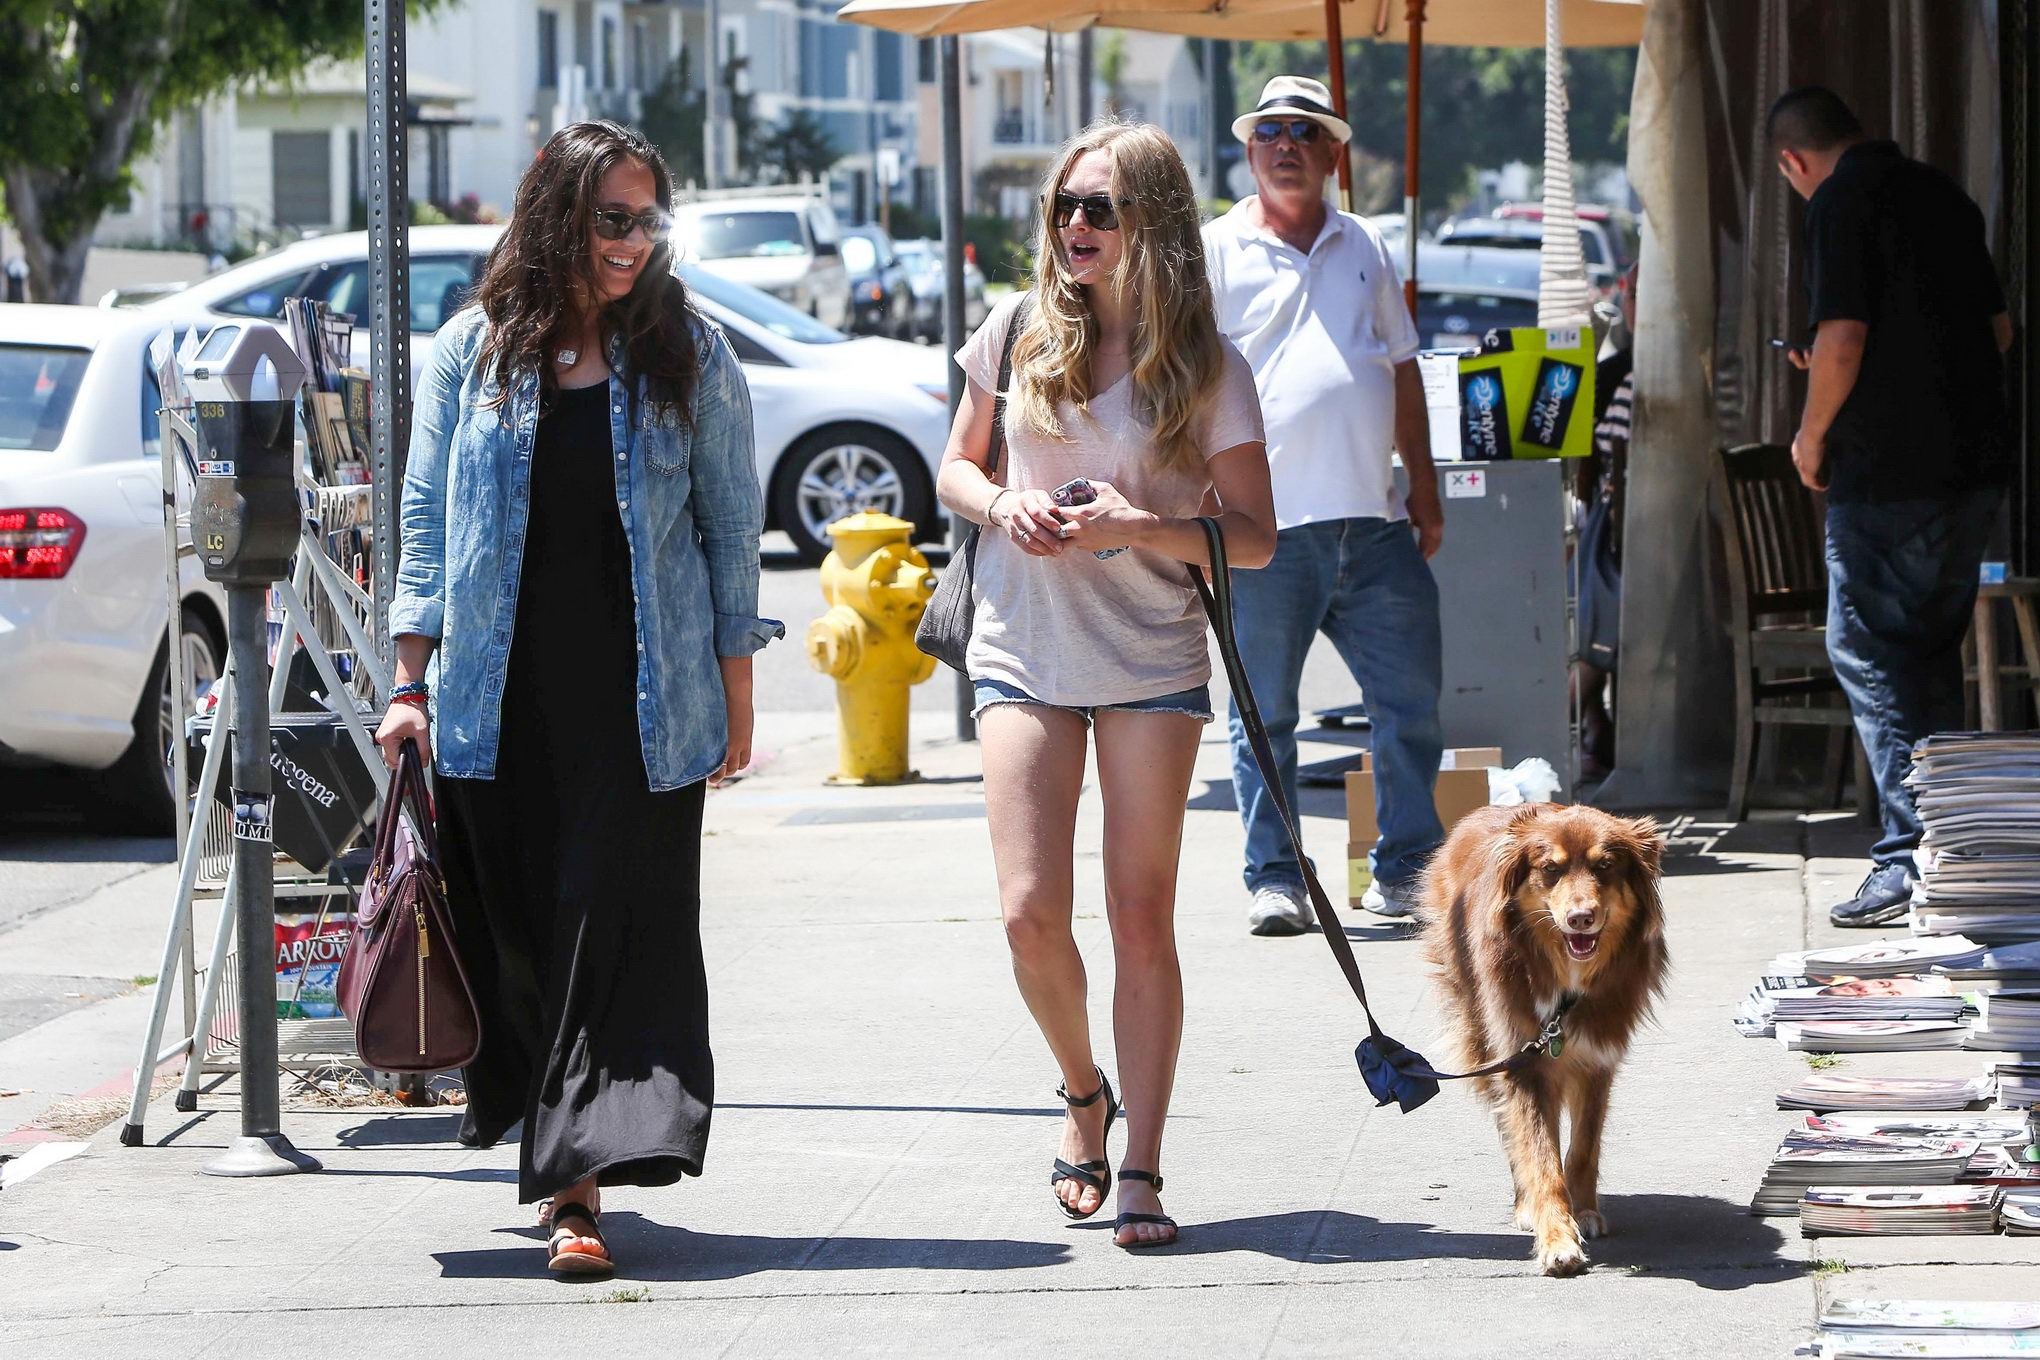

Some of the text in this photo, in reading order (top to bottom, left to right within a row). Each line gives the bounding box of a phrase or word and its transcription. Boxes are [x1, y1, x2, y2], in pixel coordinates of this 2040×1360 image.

[1475, 375, 1498, 456] Dentyne
[1539, 364, 1572, 444] Dentyne
[207, 535, 224, 550] LC
